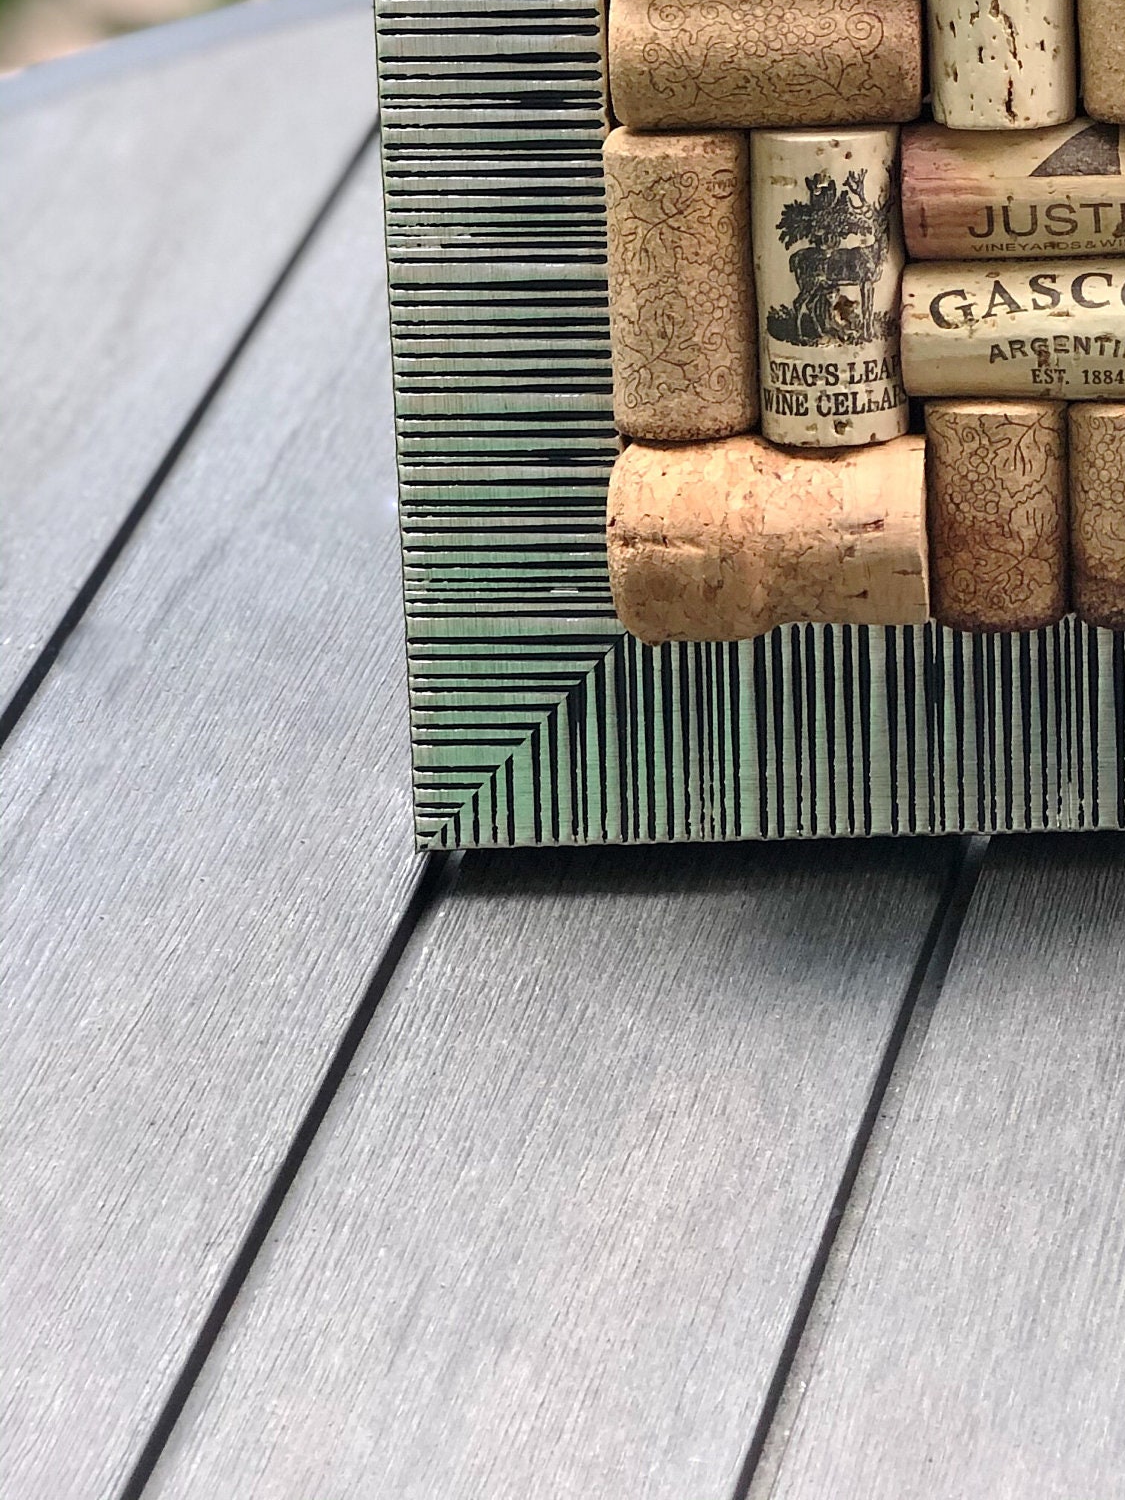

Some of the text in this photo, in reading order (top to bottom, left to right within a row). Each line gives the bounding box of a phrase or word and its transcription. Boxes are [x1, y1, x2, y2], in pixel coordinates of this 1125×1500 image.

[770, 360, 840, 387] STAG'S
[1031, 368, 1125, 385] EST. 1884
[763, 387, 809, 417] WINE
